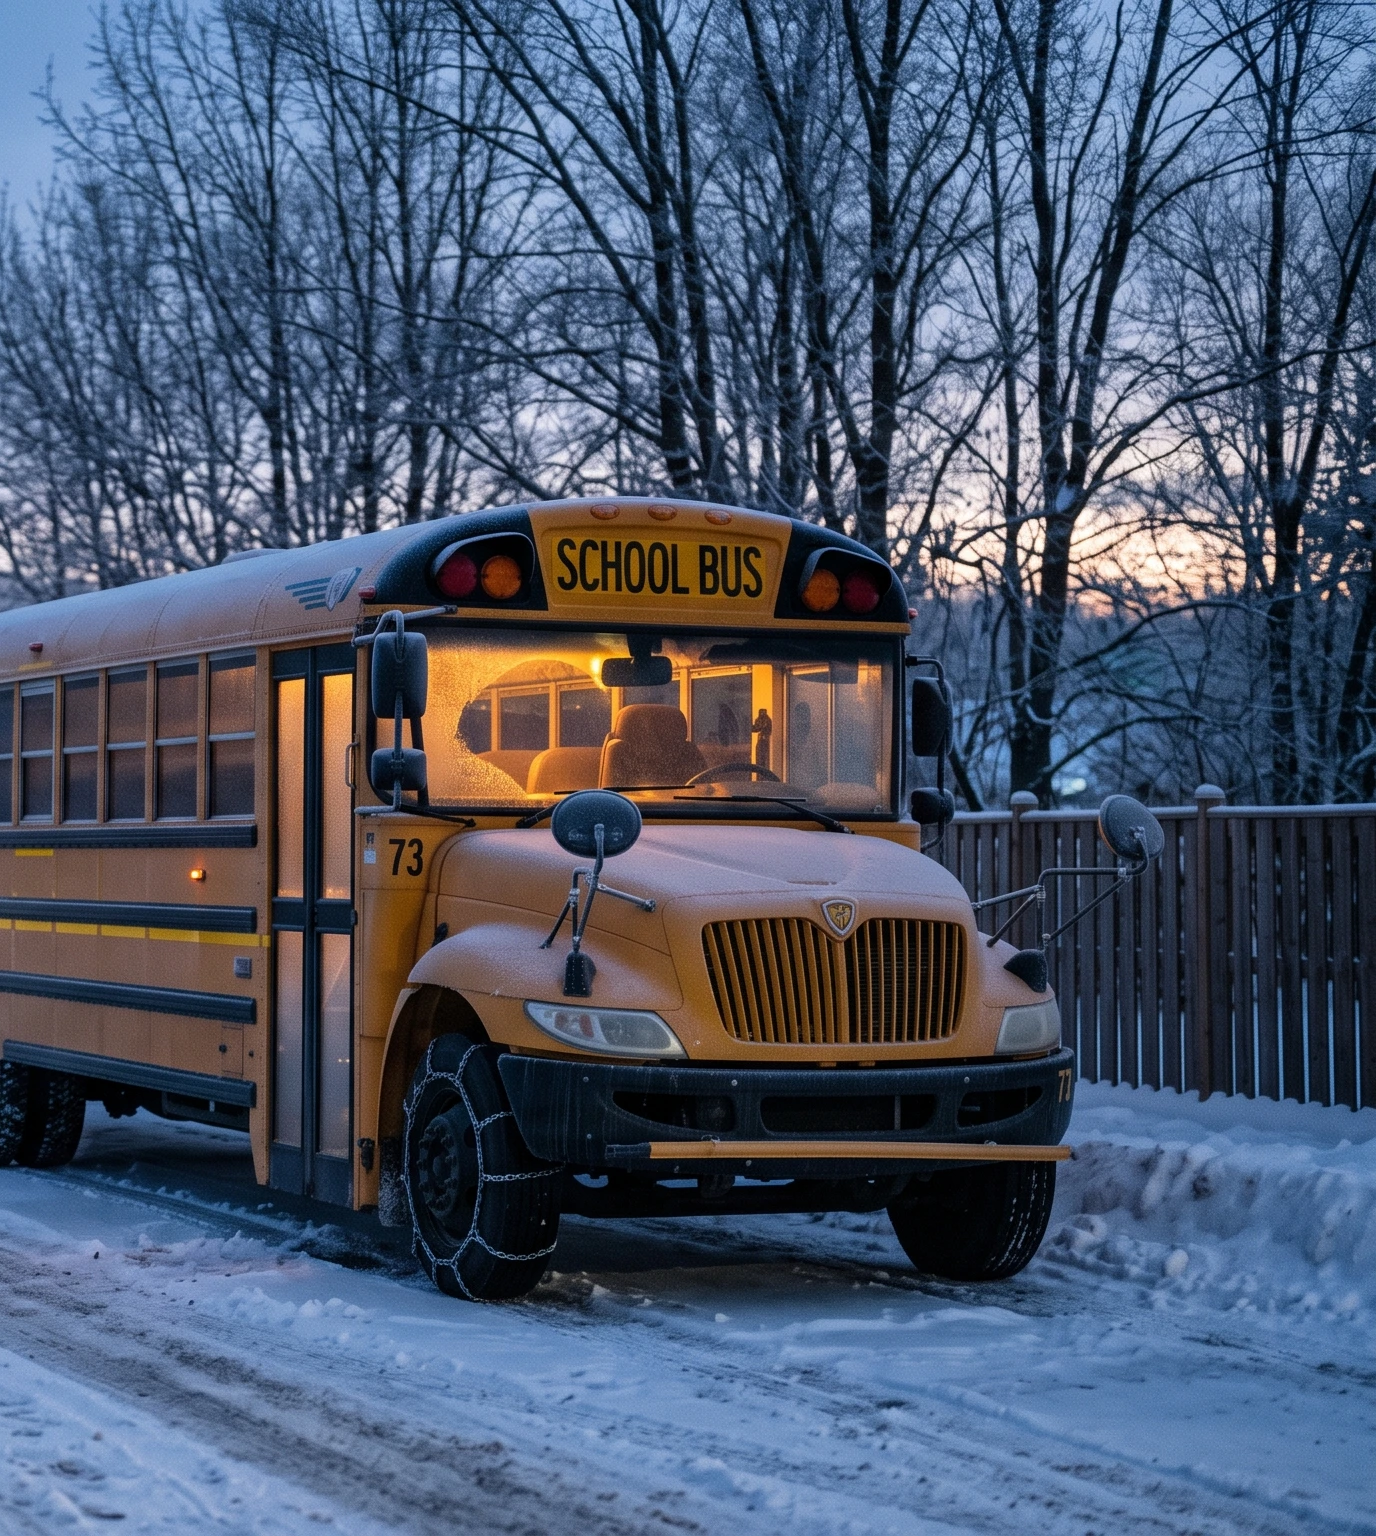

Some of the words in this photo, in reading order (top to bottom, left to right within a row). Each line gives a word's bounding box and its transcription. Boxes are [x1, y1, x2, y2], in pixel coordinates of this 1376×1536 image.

[557, 537, 690, 595] SCHOOL
[699, 544, 763, 598] BUS
[388, 838, 424, 877] 73
